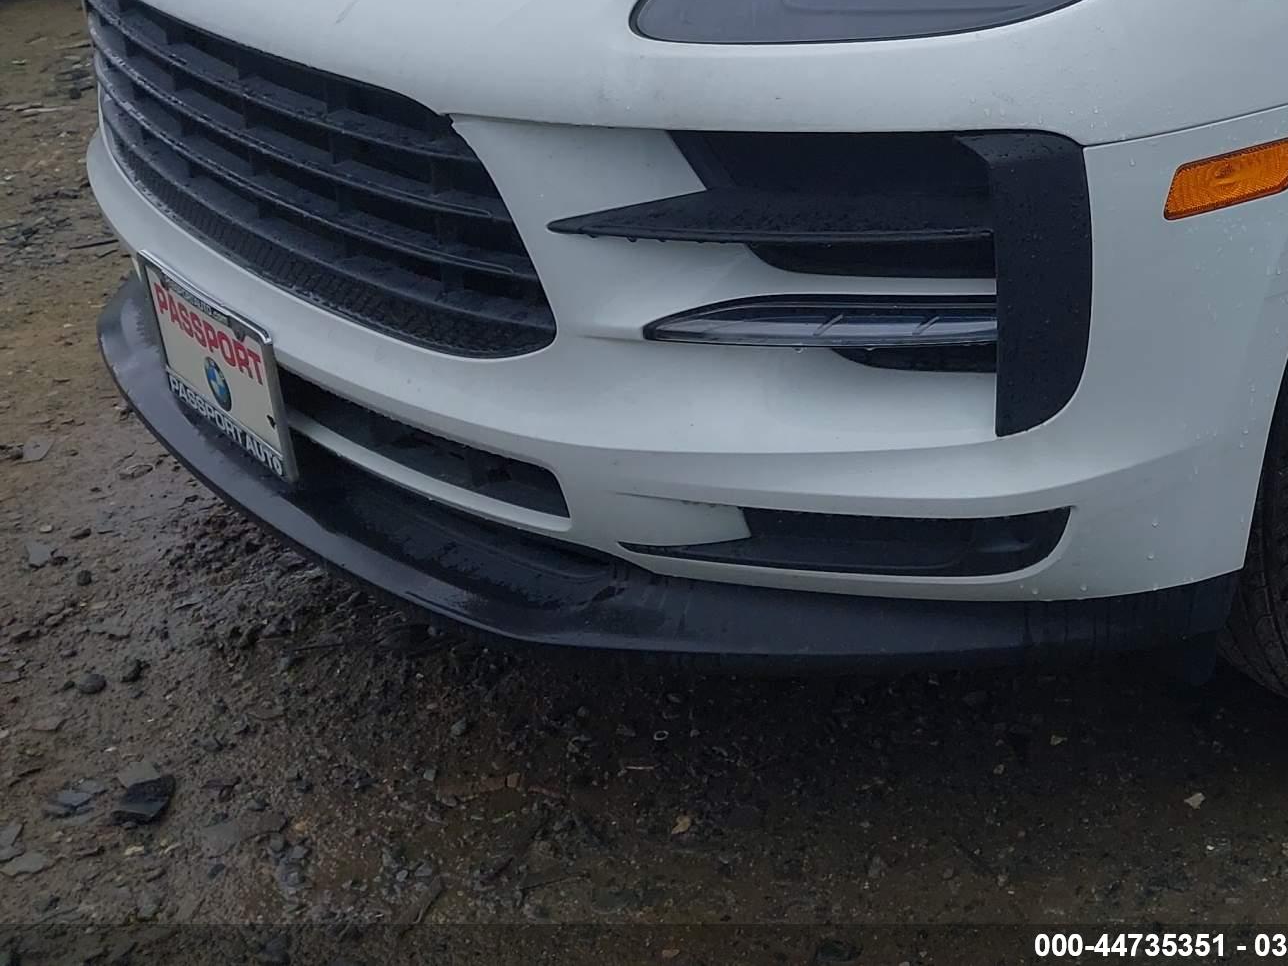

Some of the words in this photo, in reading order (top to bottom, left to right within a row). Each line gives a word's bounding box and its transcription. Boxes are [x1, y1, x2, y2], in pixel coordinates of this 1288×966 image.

[154, 283, 263, 385] PASSPORT
[169, 377, 244, 445] PASSPORT
[246, 433, 282, 476] AUTO
